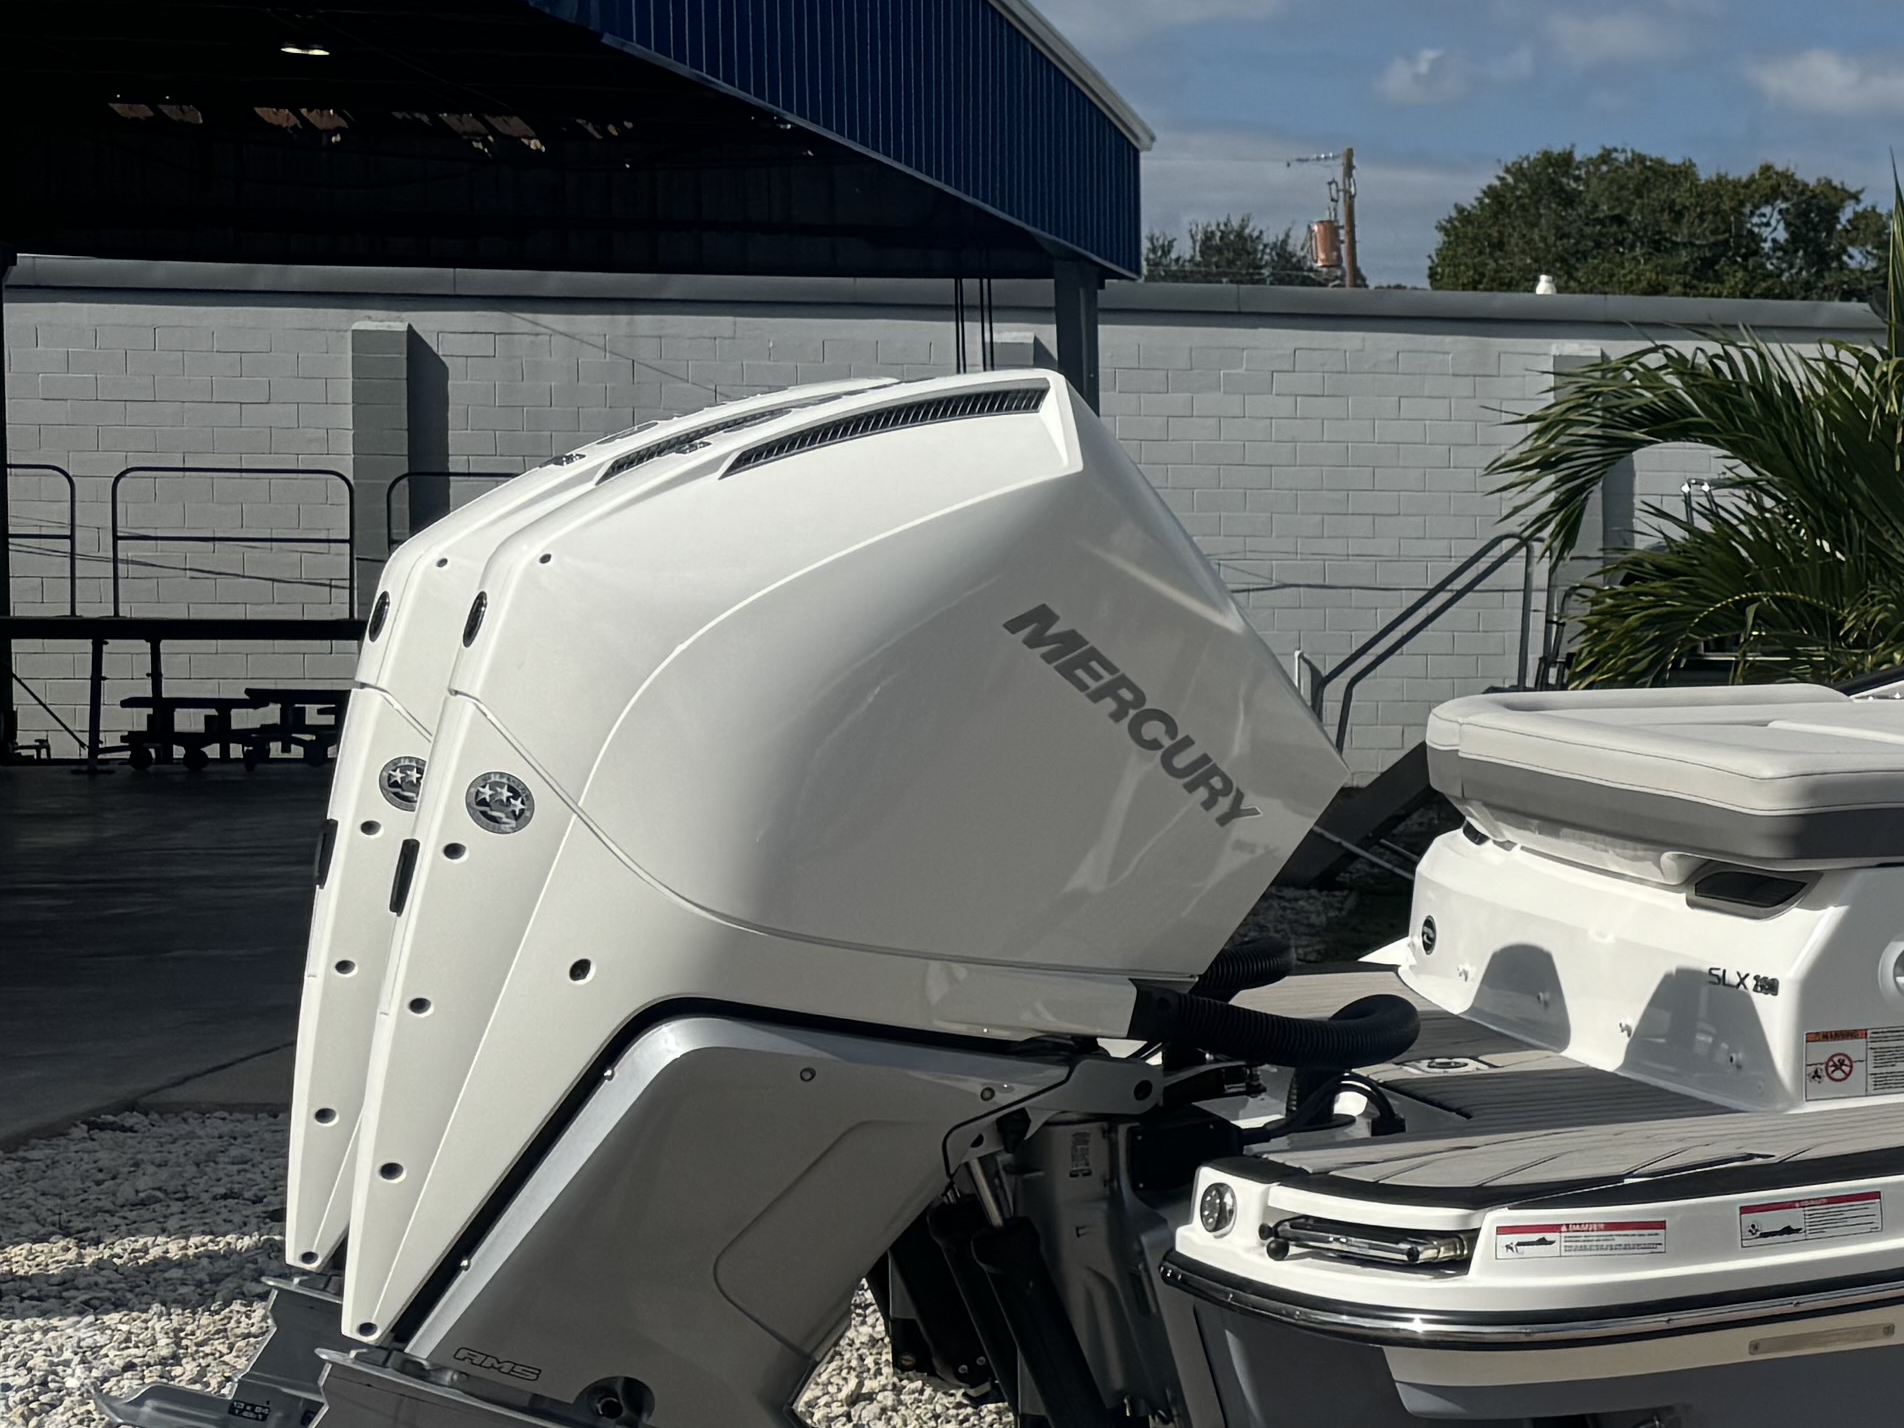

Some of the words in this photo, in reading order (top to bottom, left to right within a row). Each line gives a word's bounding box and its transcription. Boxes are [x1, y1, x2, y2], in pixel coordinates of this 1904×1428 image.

[1003, 603, 1263, 827] MERCURY
[1708, 967, 1750, 990] SLX
[453, 1347, 542, 1382] AMS
